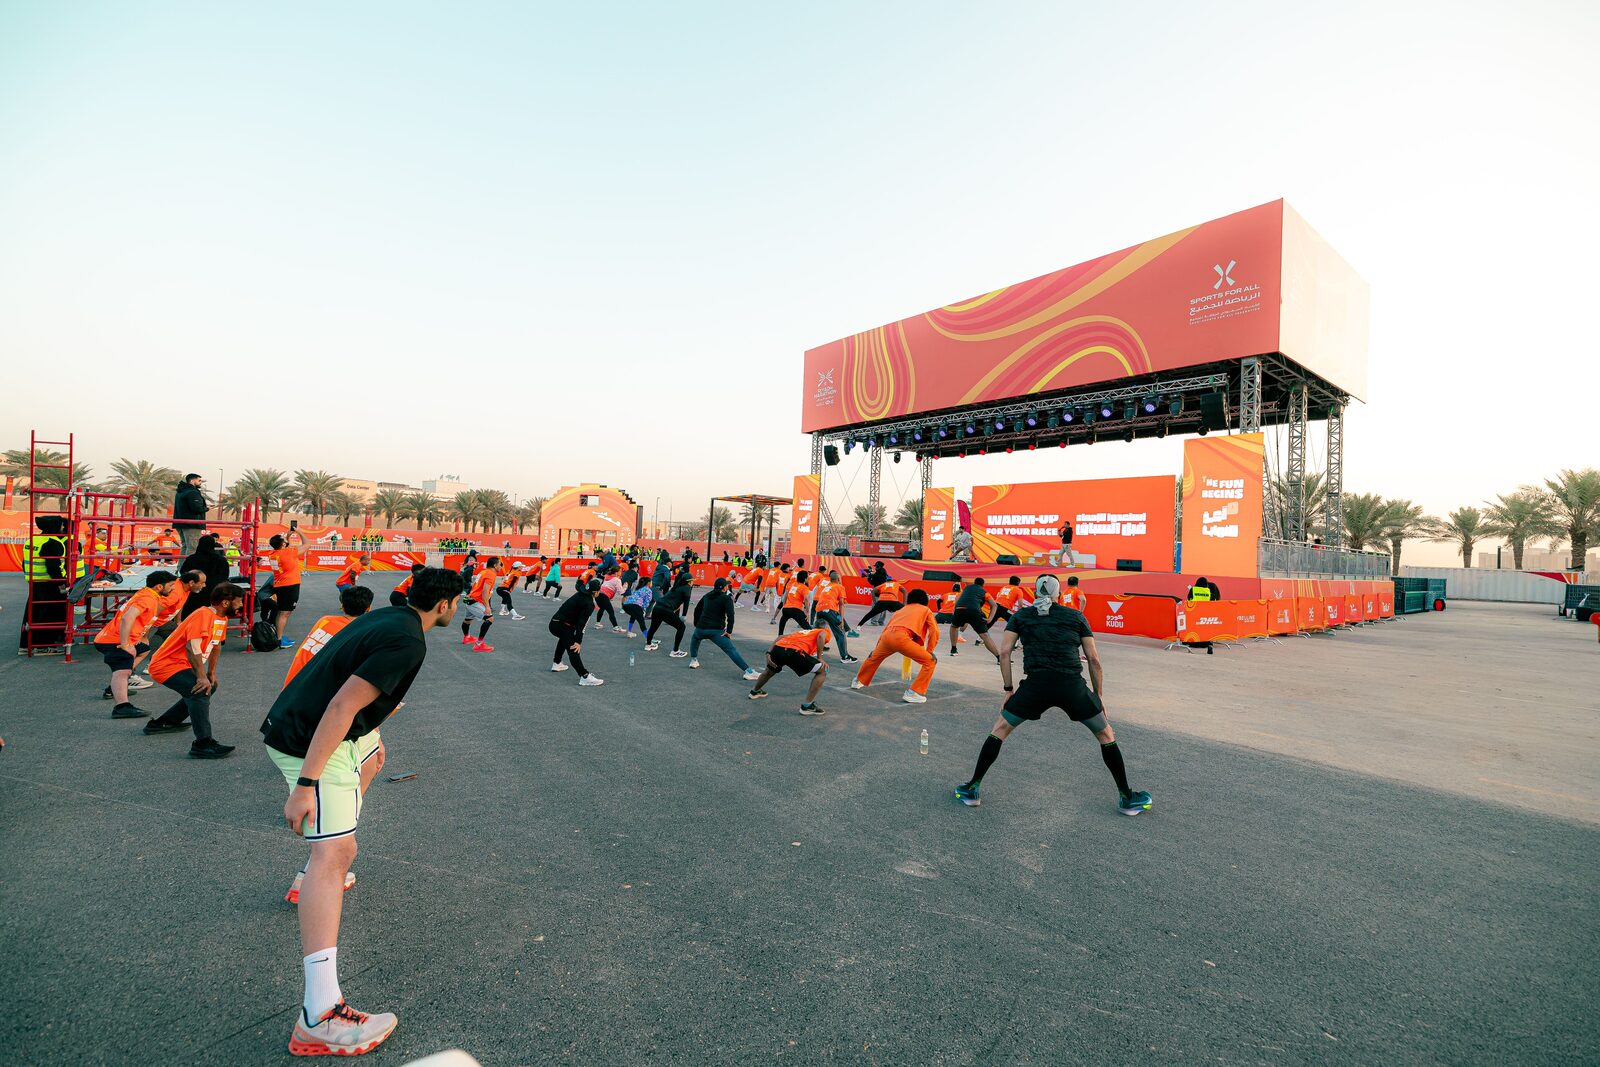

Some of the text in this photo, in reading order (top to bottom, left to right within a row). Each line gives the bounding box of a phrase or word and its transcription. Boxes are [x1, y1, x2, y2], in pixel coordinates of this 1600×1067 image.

[1190, 284, 1260, 305] SPORTS FOR ALL
[1225, 291, 1261, 305] الرياضة
[1219, 479, 1244, 489] FUN
[1201, 489, 1244, 499] BEGINS
[987, 514, 1059, 526] WARM-UP
[1004, 528, 1030, 536] YOUR
[1031, 528, 1058, 536] RACE
[1197, 616, 1221, 625] DHL
